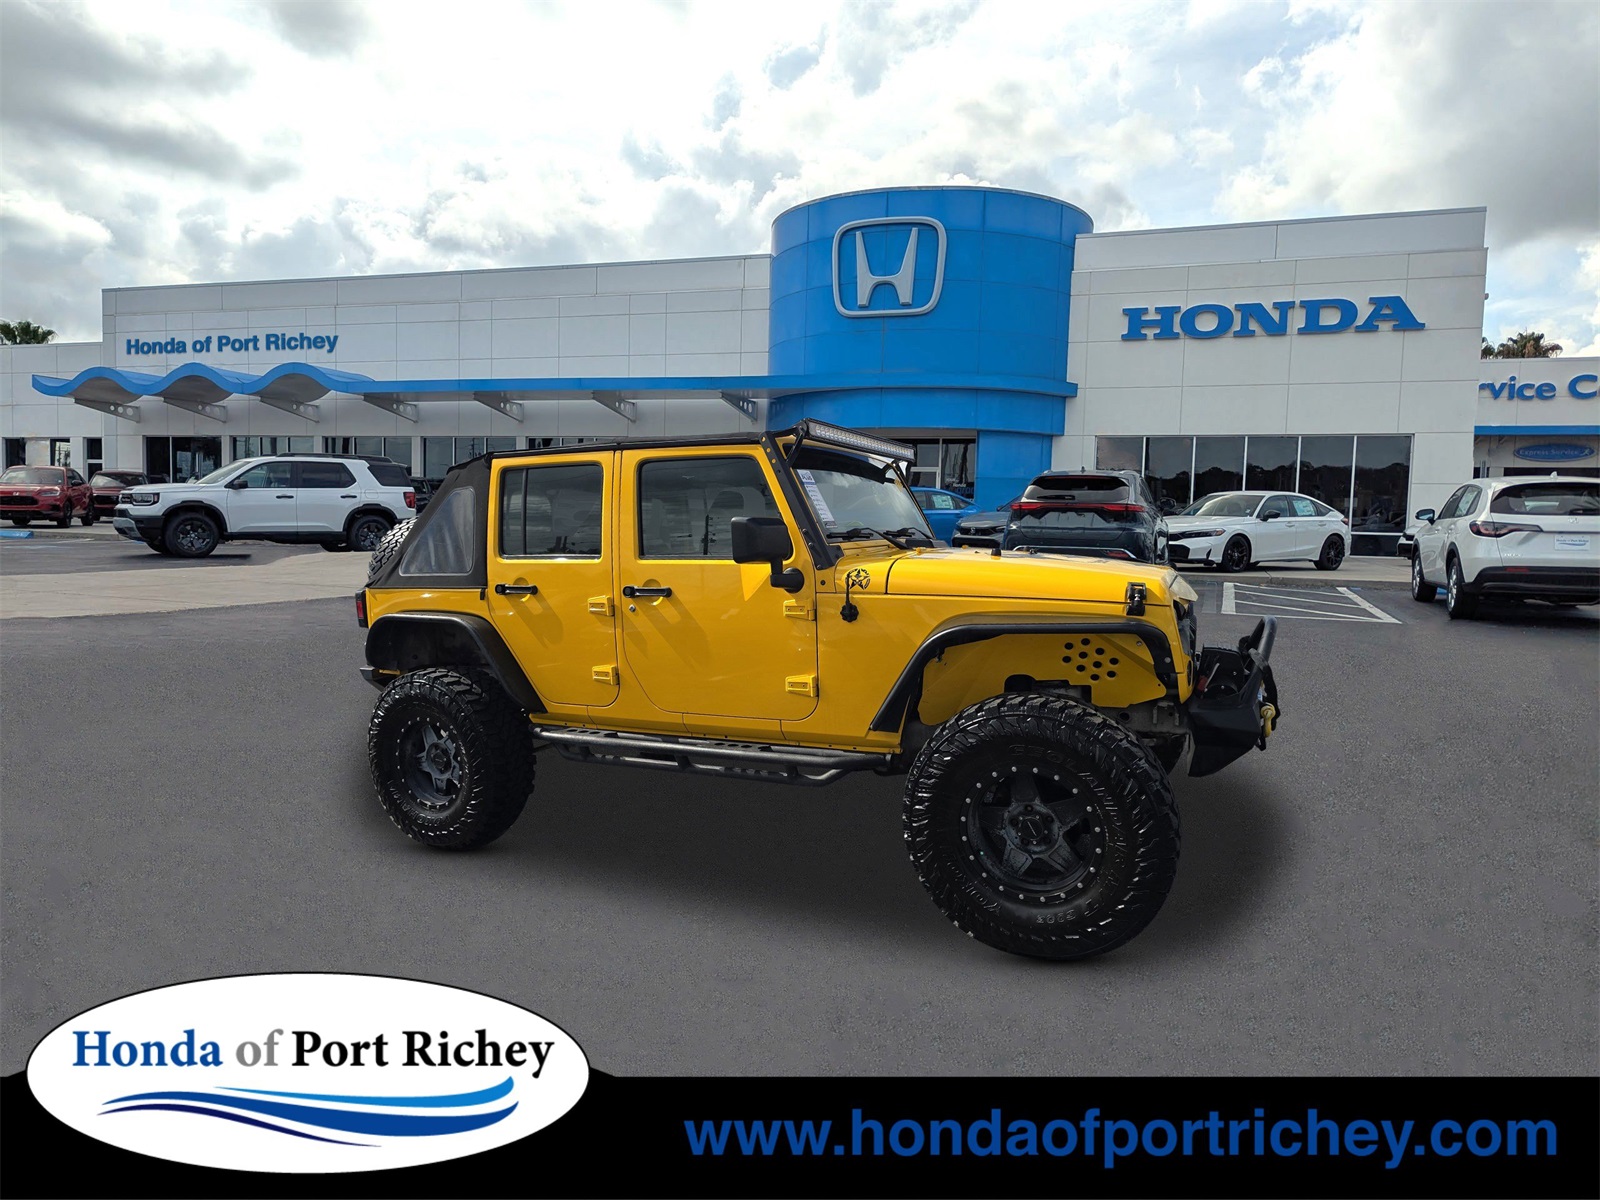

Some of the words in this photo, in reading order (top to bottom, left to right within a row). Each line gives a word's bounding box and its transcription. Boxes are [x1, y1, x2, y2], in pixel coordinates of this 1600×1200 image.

[1121, 296, 1426, 340] HONDA
[126, 337, 187, 355] Honda
[192, 335, 213, 353] of
[217, 335, 260, 352] Port
[265, 332, 339, 353] Richey
[1568, 374, 1600, 399] C
